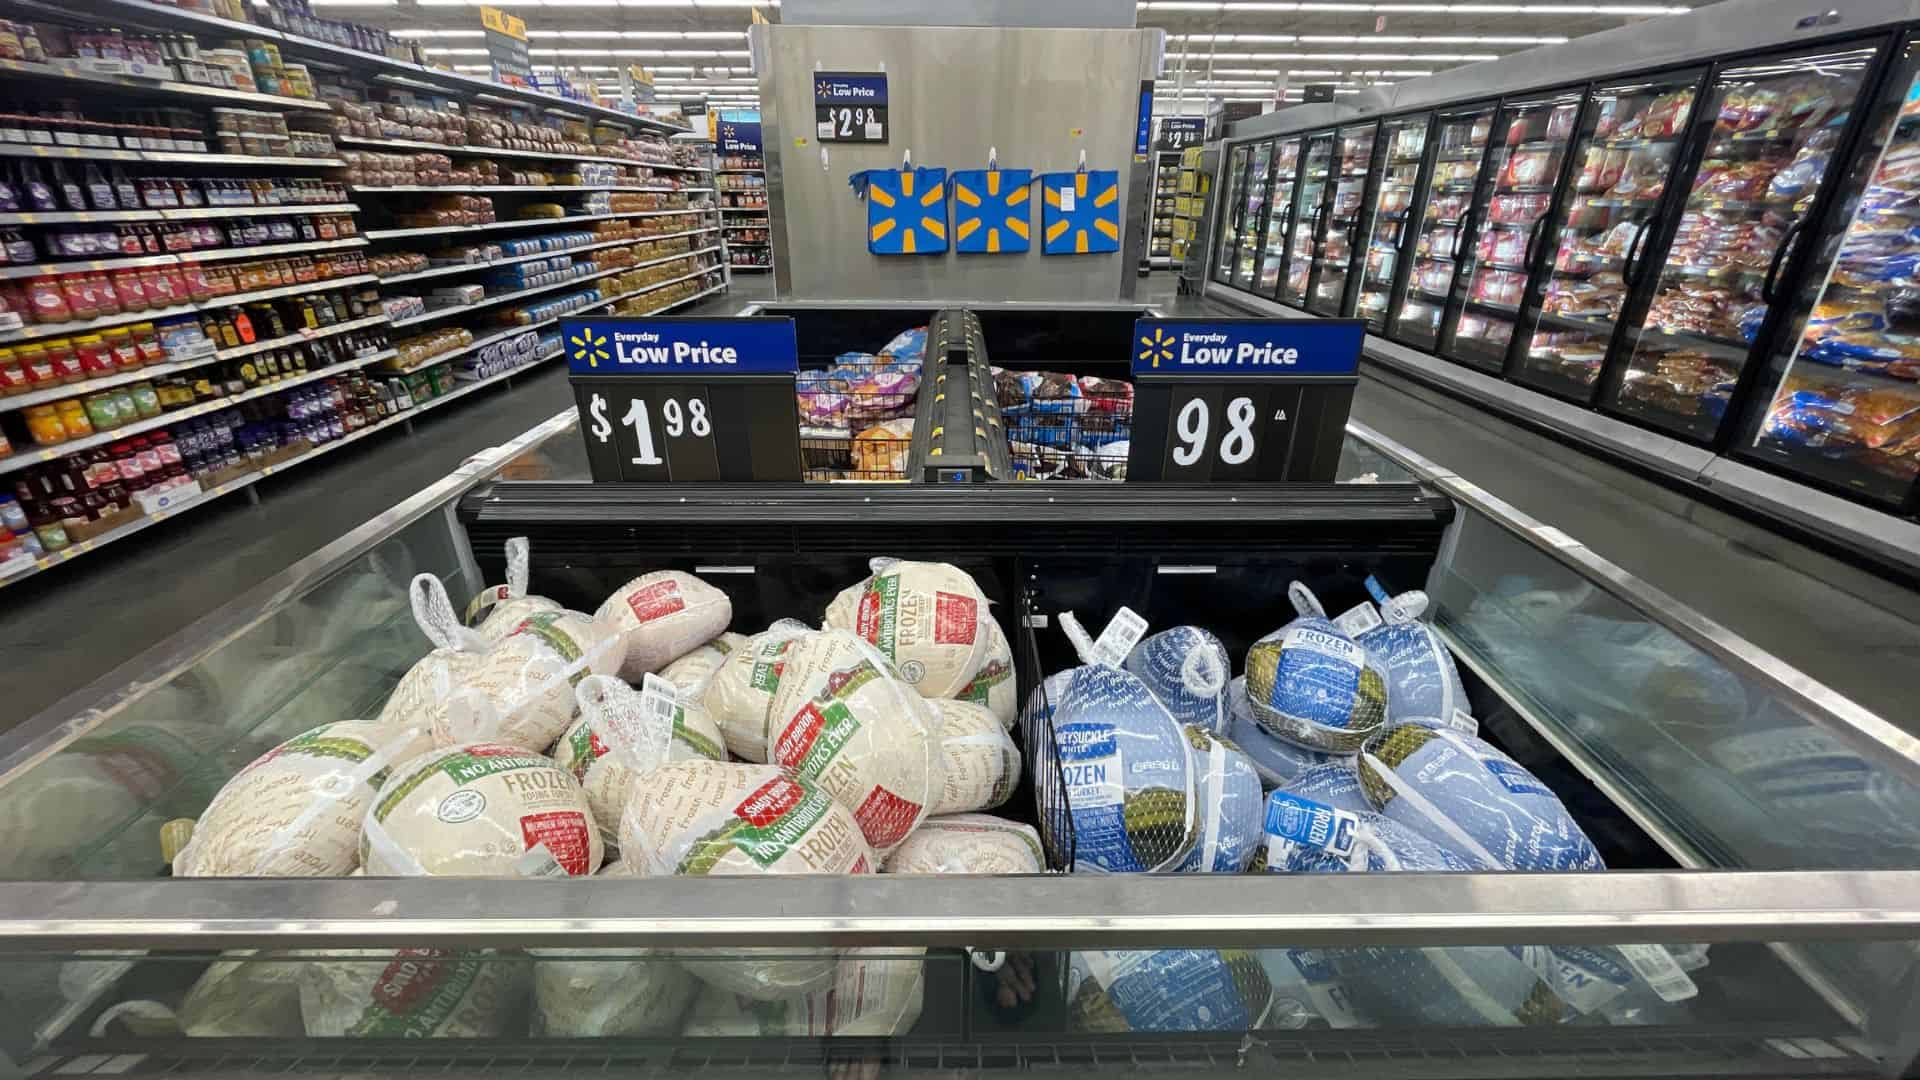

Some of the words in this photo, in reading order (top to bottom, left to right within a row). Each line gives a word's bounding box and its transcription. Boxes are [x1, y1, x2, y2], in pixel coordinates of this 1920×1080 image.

[834, 88, 850, 96] Low
[853, 87, 874, 96] Price
[614, 332, 659, 343] Everyday
[1184, 333, 1227, 344] Everyday
[616, 342, 668, 363] Low
[673, 342, 736, 364] Price
[1181, 342, 1232, 364] Low
[1236, 342, 1298, 364] Price
[1173, 397, 1256, 466] 98
[900, 590, 918, 646] FROZEN
[1297, 630, 1353, 653] FROZEN
[754, 662, 769, 687] EVER
[829, 717, 854, 748] EVER
[461, 764, 486, 778] NO
[1063, 764, 1106, 786] OZEN
[777, 802, 824, 844] ANTIBIOTICS
[1309, 807, 1332, 845] FROZEN
[798, 810, 850, 870] FROZEN
